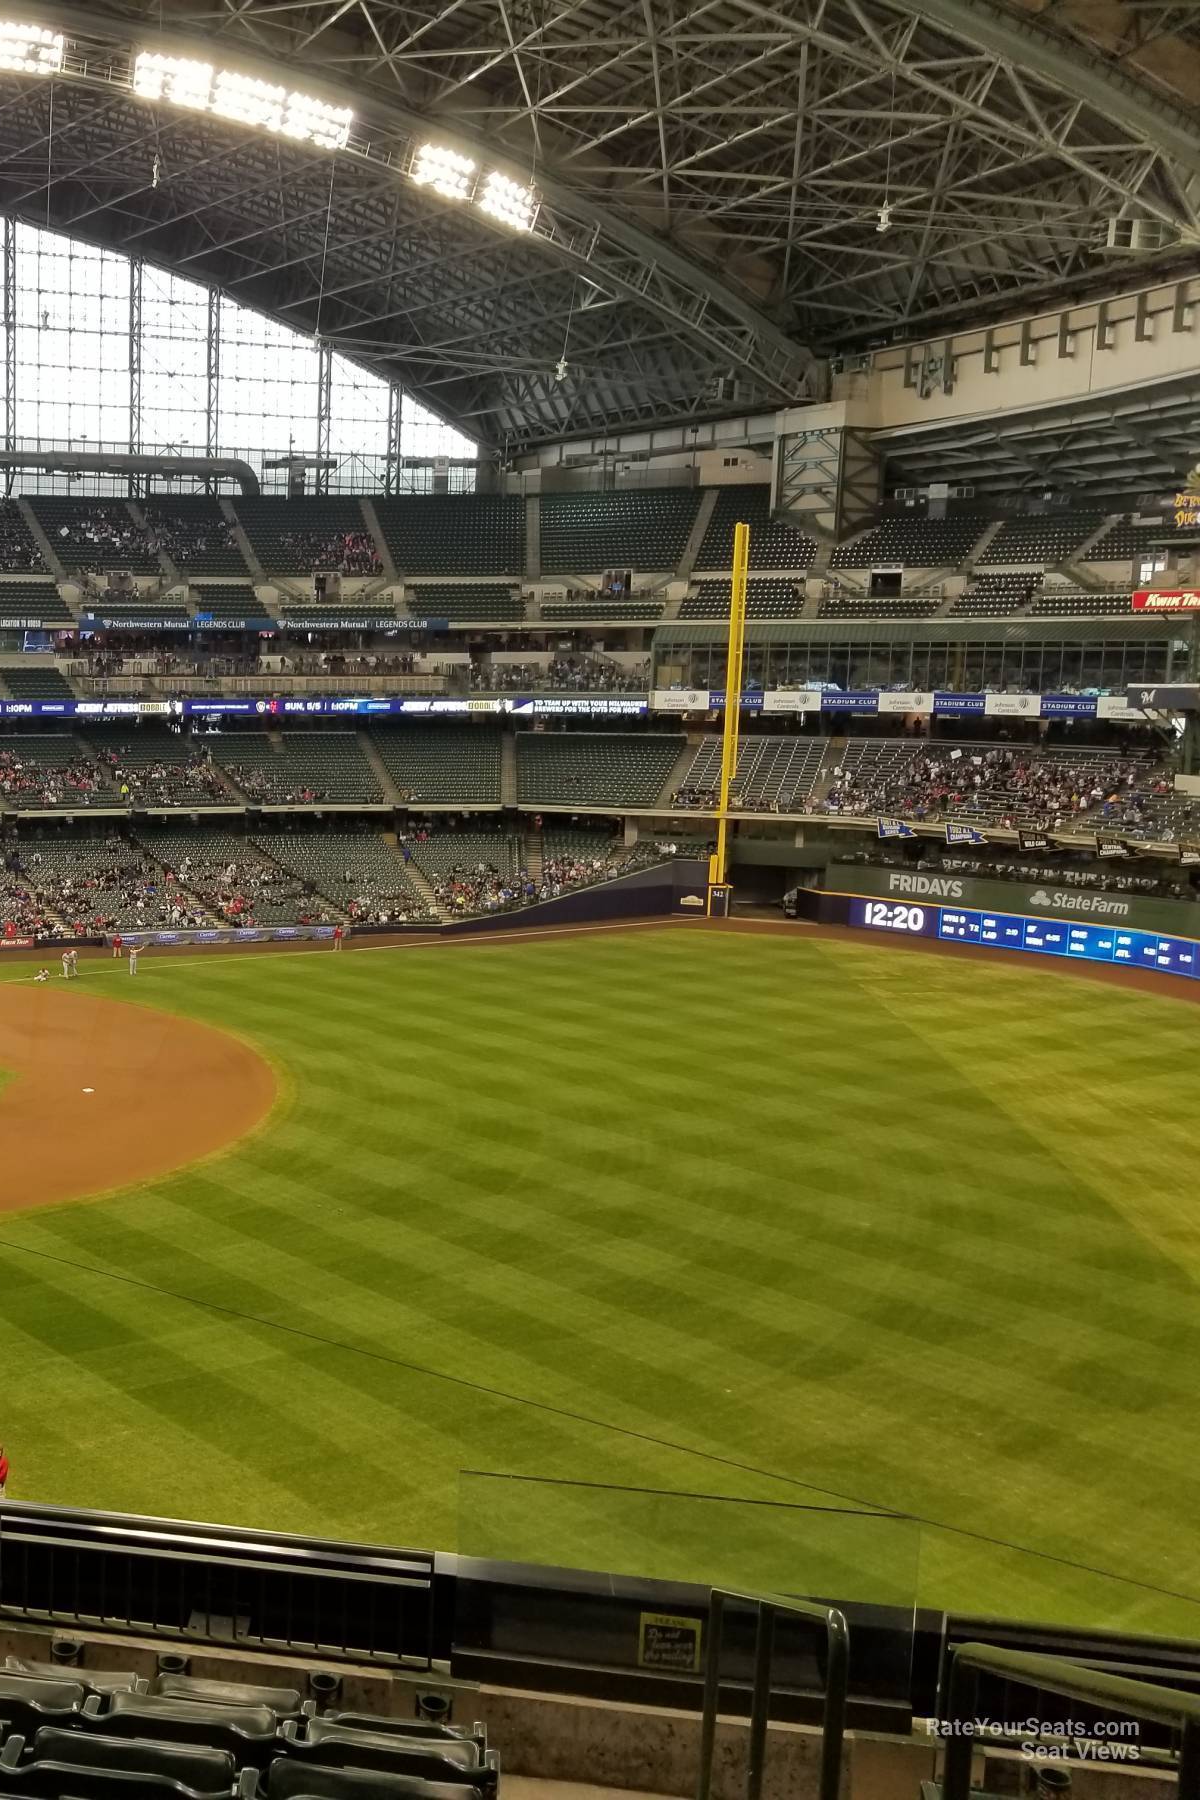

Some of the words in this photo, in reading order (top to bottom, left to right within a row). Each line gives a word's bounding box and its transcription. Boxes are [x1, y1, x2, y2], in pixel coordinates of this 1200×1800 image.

[1145, 593, 1182, 606] KWIK
[112, 620, 162, 628] Northwestern
[163, 620, 190, 628] Mutual
[287, 620, 339, 629] Northwestern
[340, 620, 367, 629] Mutual
[375, 620, 408, 628] LEGENDS
[408, 620, 428, 628] CLUB
[889, 873, 963, 898] FRIDAYS
[1052, 892, 1129, 916] StateFarm
[864, 902, 925, 931] 12:20
